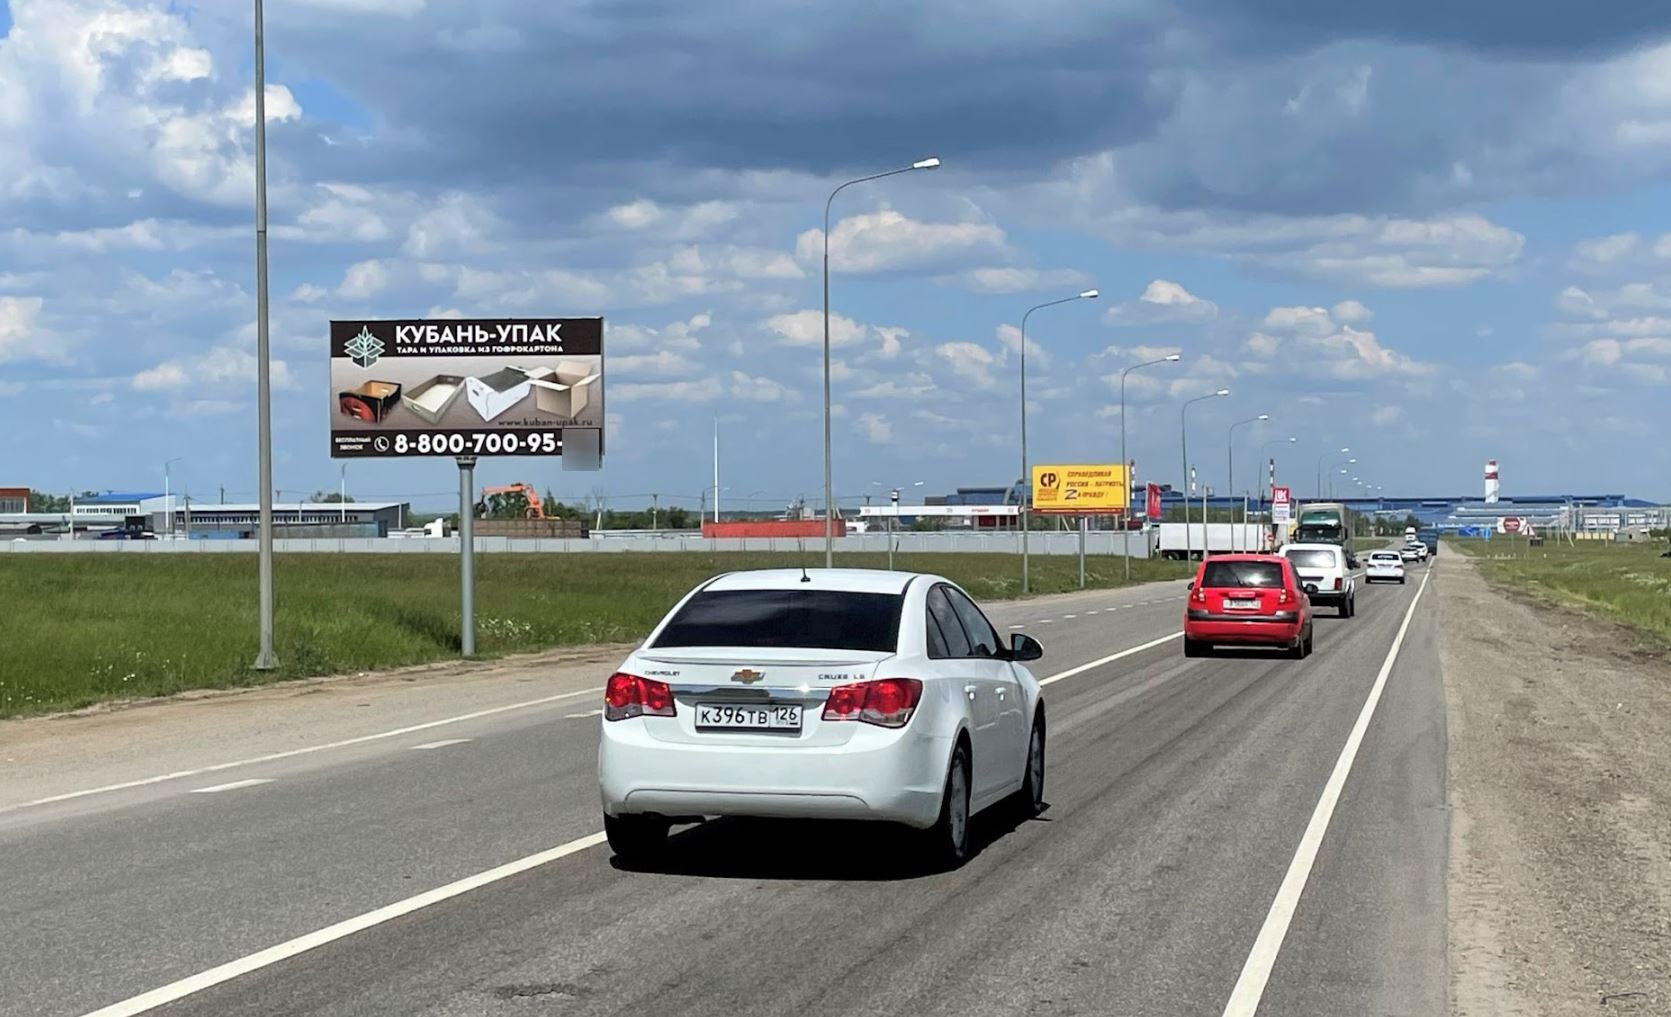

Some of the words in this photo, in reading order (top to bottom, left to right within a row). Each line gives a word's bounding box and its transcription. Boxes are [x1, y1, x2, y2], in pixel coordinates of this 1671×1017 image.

[395, 323, 563, 344] КУБАНЬ-УПАК
[396, 346, 418, 354] ТАРА
[420, 346, 427, 354] И
[429, 345, 476, 354] УПАКОВКА
[478, 345, 490, 353] ИЗ
[492, 344, 564, 353] ГОФРОКАРТОНА
[498, 417, 593, 428] www.kuban-upak.ru
[394, 432, 599, 455] 8-800-700-95-
[1040, 472, 1057, 488] СР
[701, 706, 768, 725] К396ТВ
[772, 706, 798, 721] 126
